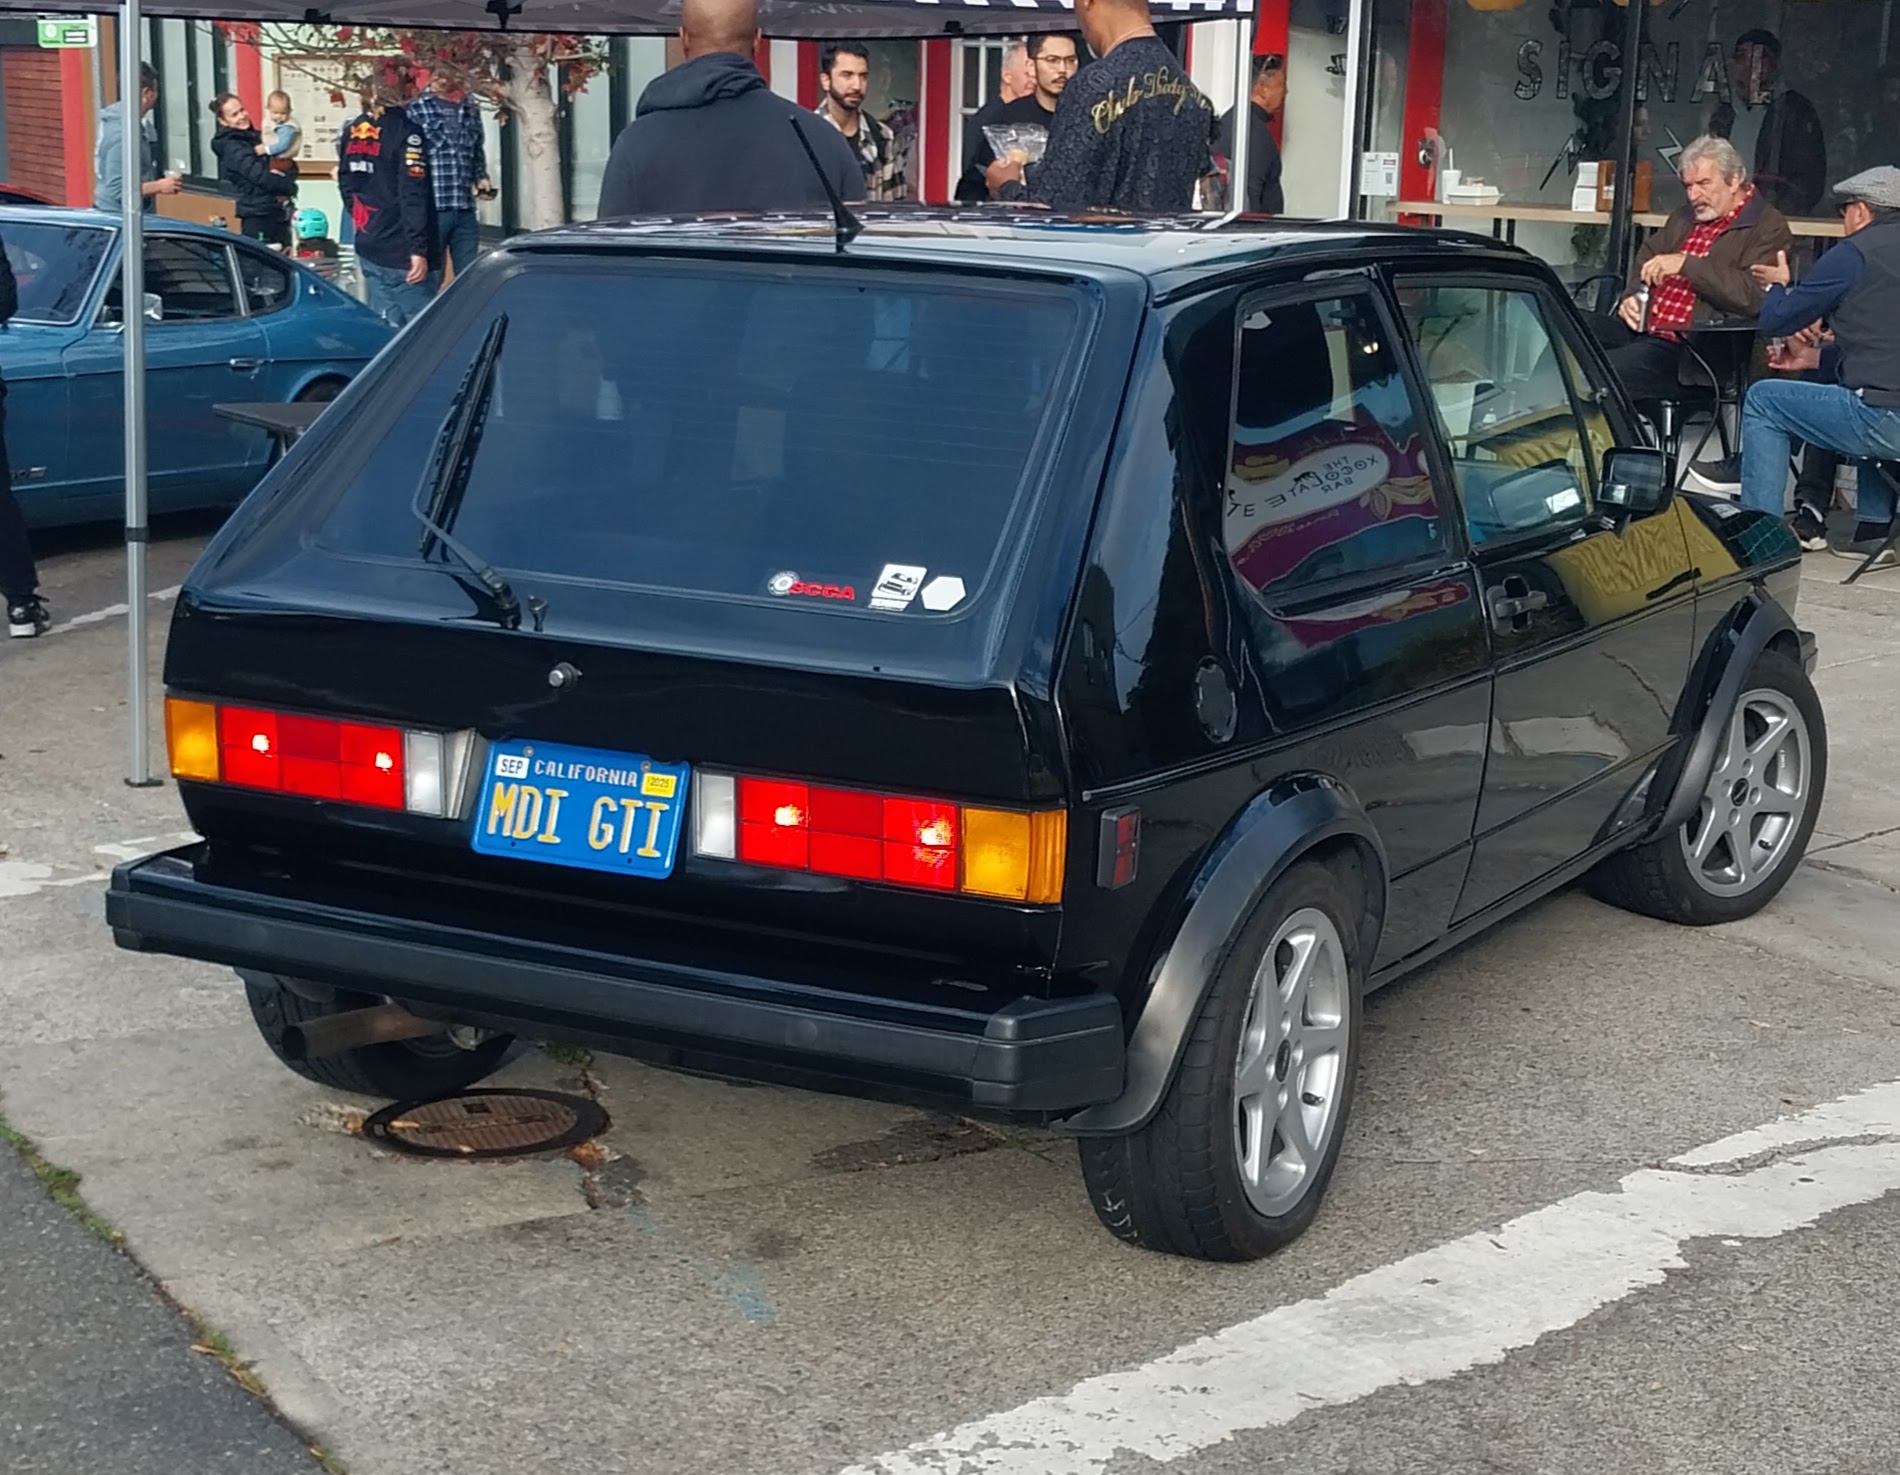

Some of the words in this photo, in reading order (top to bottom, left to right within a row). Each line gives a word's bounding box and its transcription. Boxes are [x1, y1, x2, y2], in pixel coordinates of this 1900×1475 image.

[1514, 39, 1776, 106] SIGNAL
[500, 758, 524, 775] SEP
[534, 759, 638, 787] CALIFORNIA
[487, 781, 569, 844] MDI
[588, 796, 671, 858] GTI
